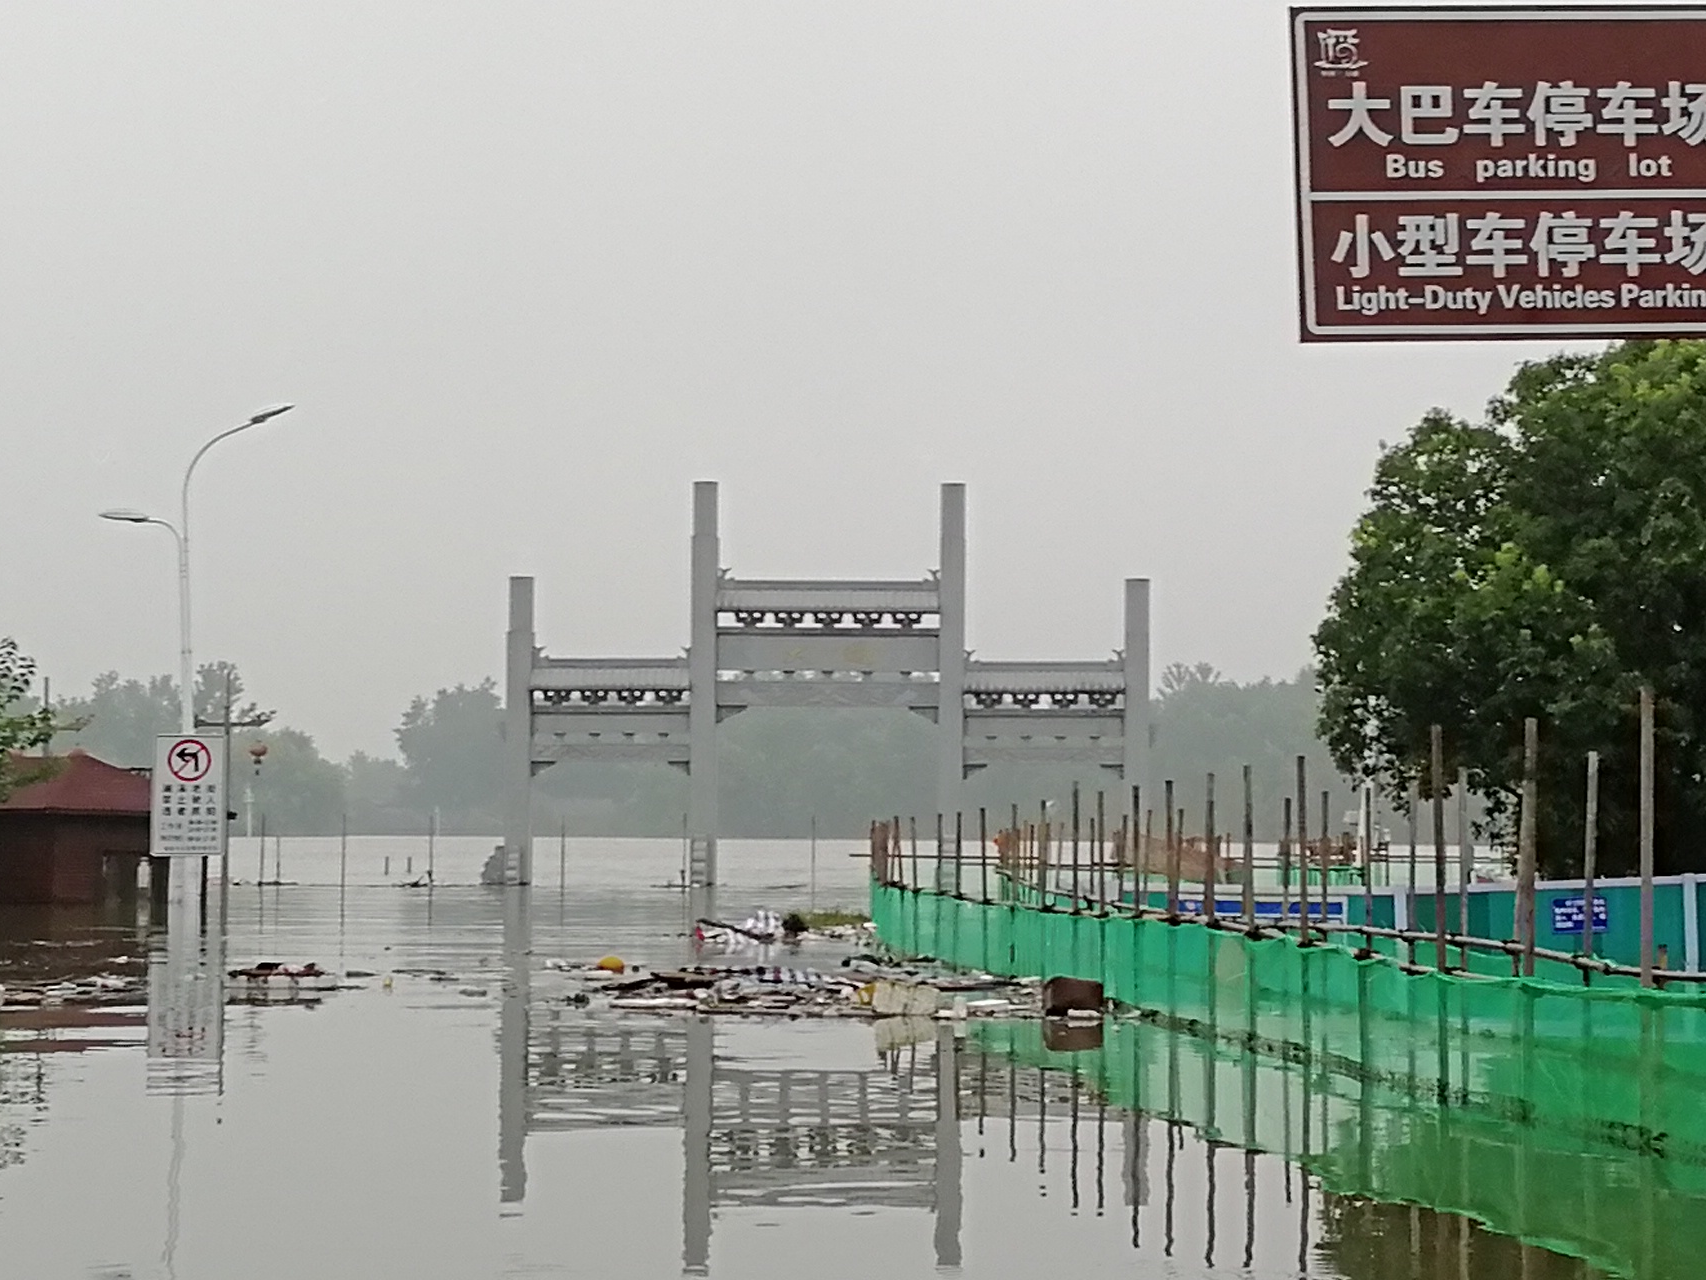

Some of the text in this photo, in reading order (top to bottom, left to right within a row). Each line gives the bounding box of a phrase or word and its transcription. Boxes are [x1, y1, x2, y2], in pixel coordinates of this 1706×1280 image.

[1386, 152, 1673, 183] Bus parking lot
[1336, 284, 1492, 316] Light-Duty
[1496, 283, 1616, 310] Vehicles
